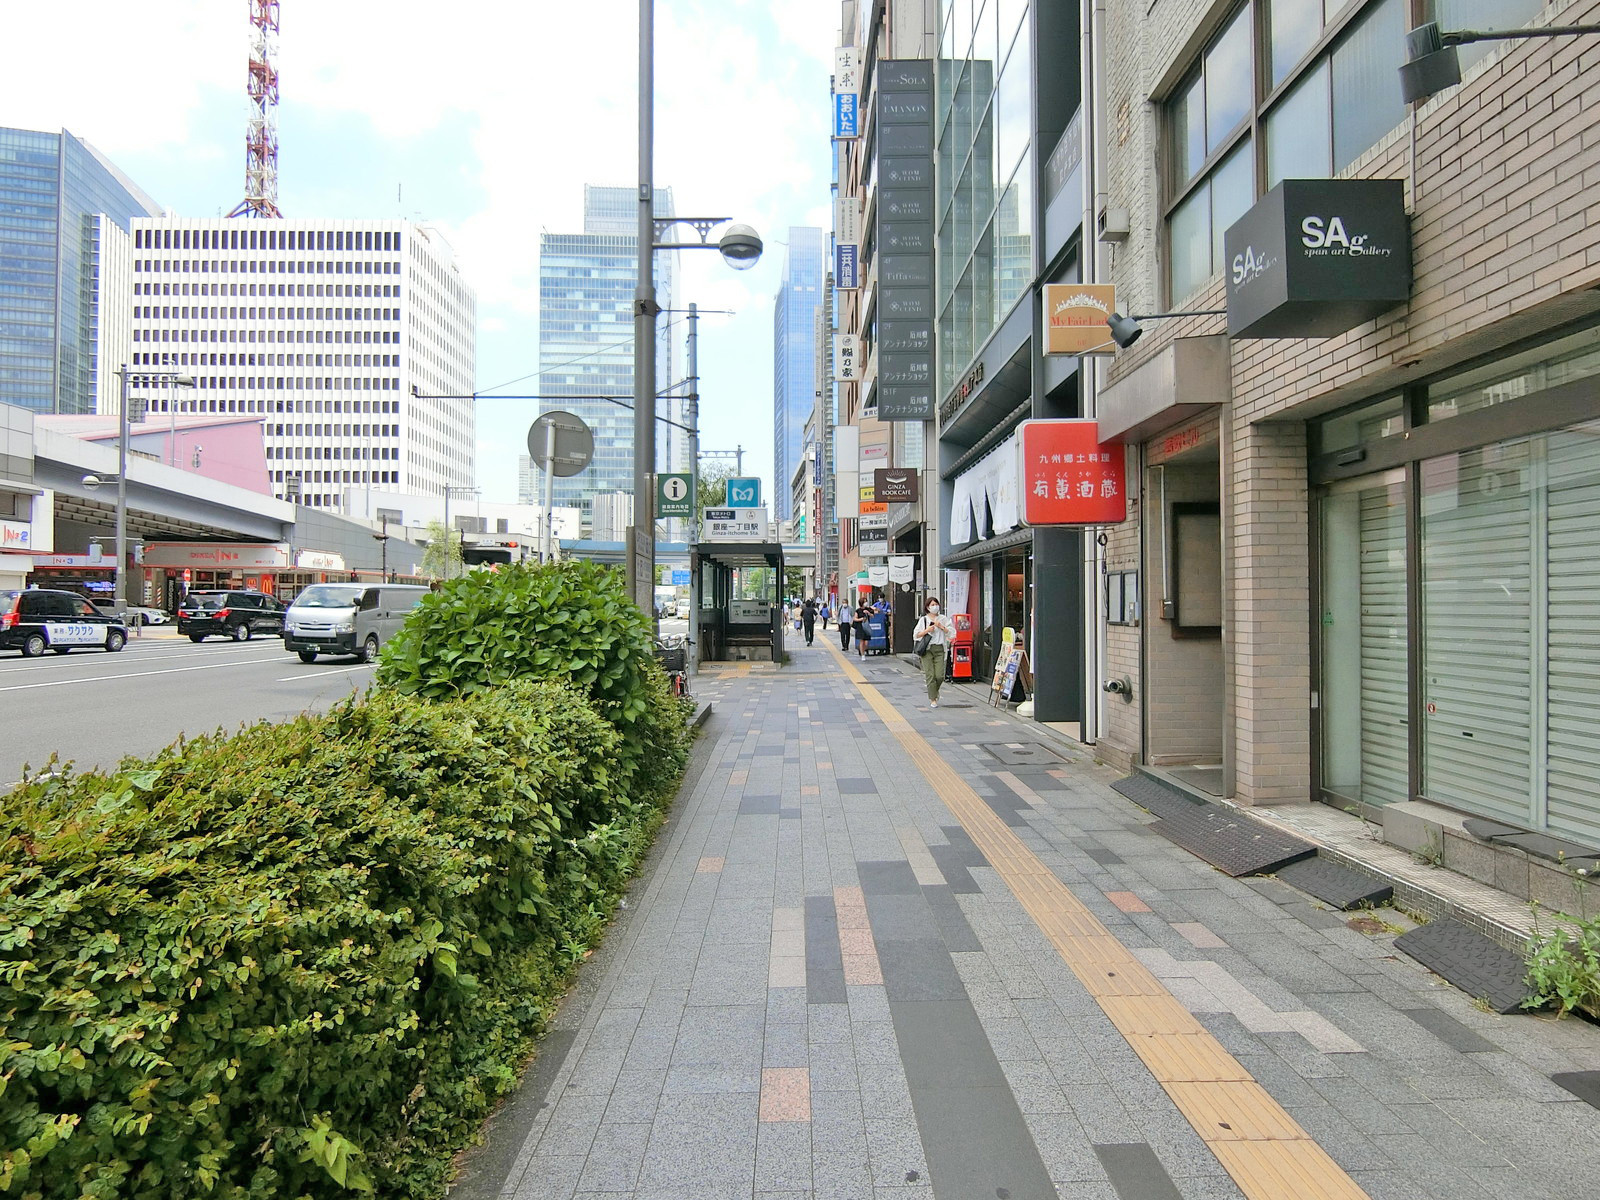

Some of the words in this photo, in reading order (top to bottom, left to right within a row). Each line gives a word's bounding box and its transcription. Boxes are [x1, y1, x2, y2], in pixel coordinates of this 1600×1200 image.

[840, 94, 854, 131] おおいた
[1304, 247, 1328, 258] span
[1331, 247, 1346, 256] art
[841, 245, 853, 287] 三共消毒
[1051, 316, 1066, 327] My
[1067, 316, 1086, 326] Fair
[884, 340, 929, 349] アンテナショップ
[884, 372, 929, 381] アンテナショップ
[883, 388, 897, 396] B1F
[884, 405, 929, 414] アンテナショップ
[1039, 453, 1110, 464] 九州郷土料理
[1032, 478, 1118, 500] 有薫酒蔵
[712, 523, 759, 531] 銀座一丁目駅
[20, 531, 29, 541] 2
